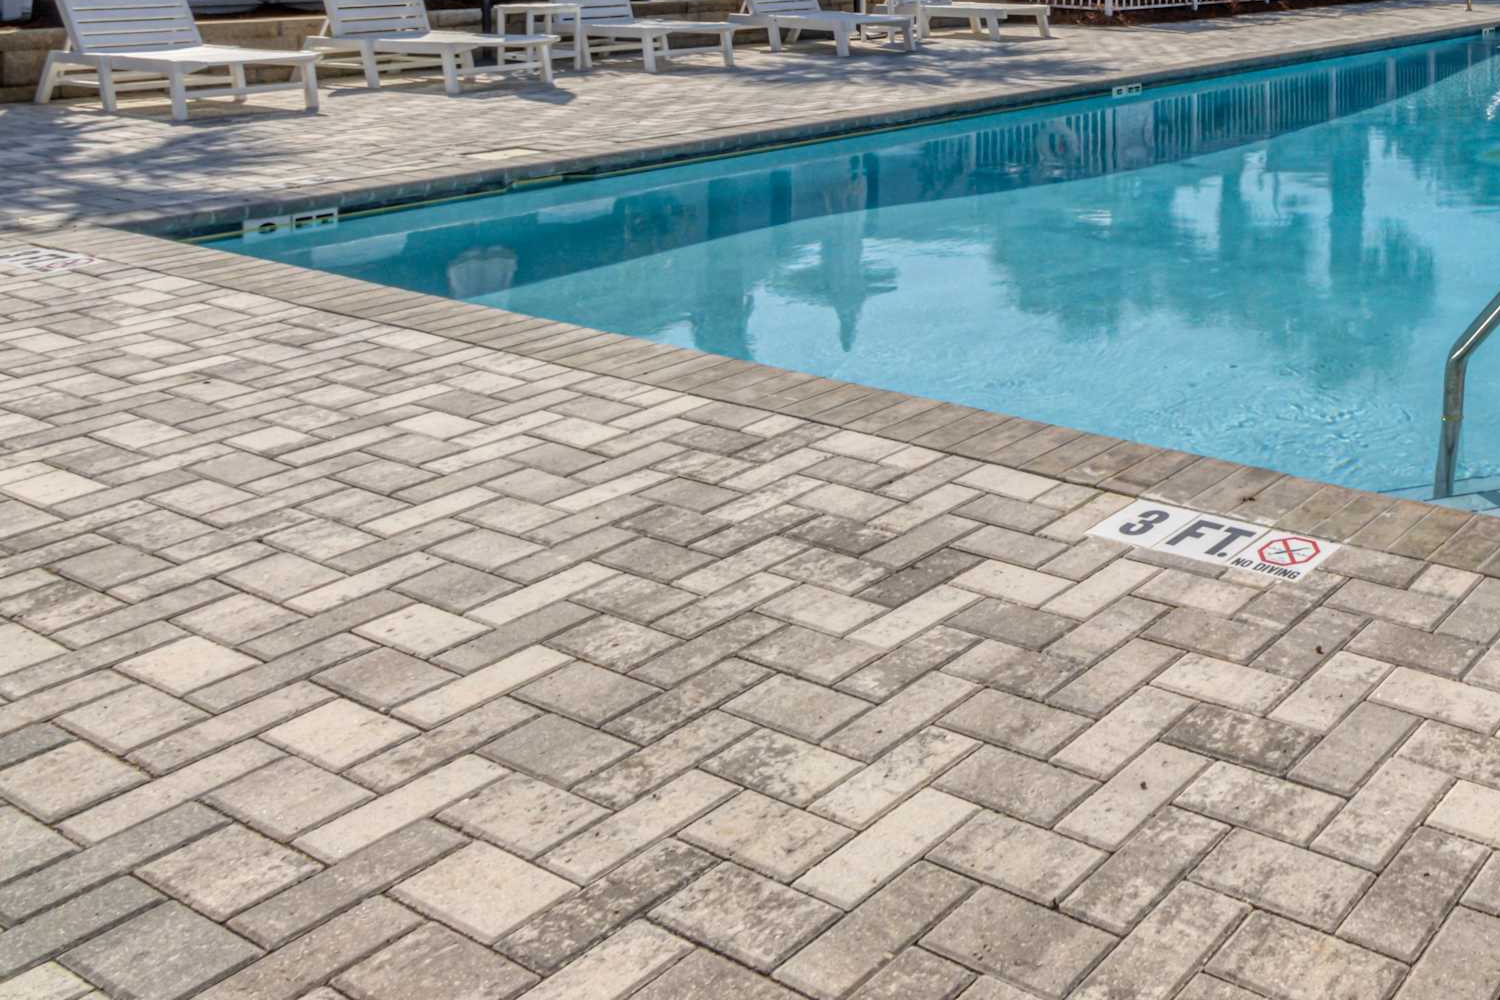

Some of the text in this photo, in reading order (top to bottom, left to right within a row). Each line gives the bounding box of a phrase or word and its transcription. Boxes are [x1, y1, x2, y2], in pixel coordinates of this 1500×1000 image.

[1119, 510, 1256, 557] 3 FT.
[1231, 557, 1300, 579] NO DIVING
